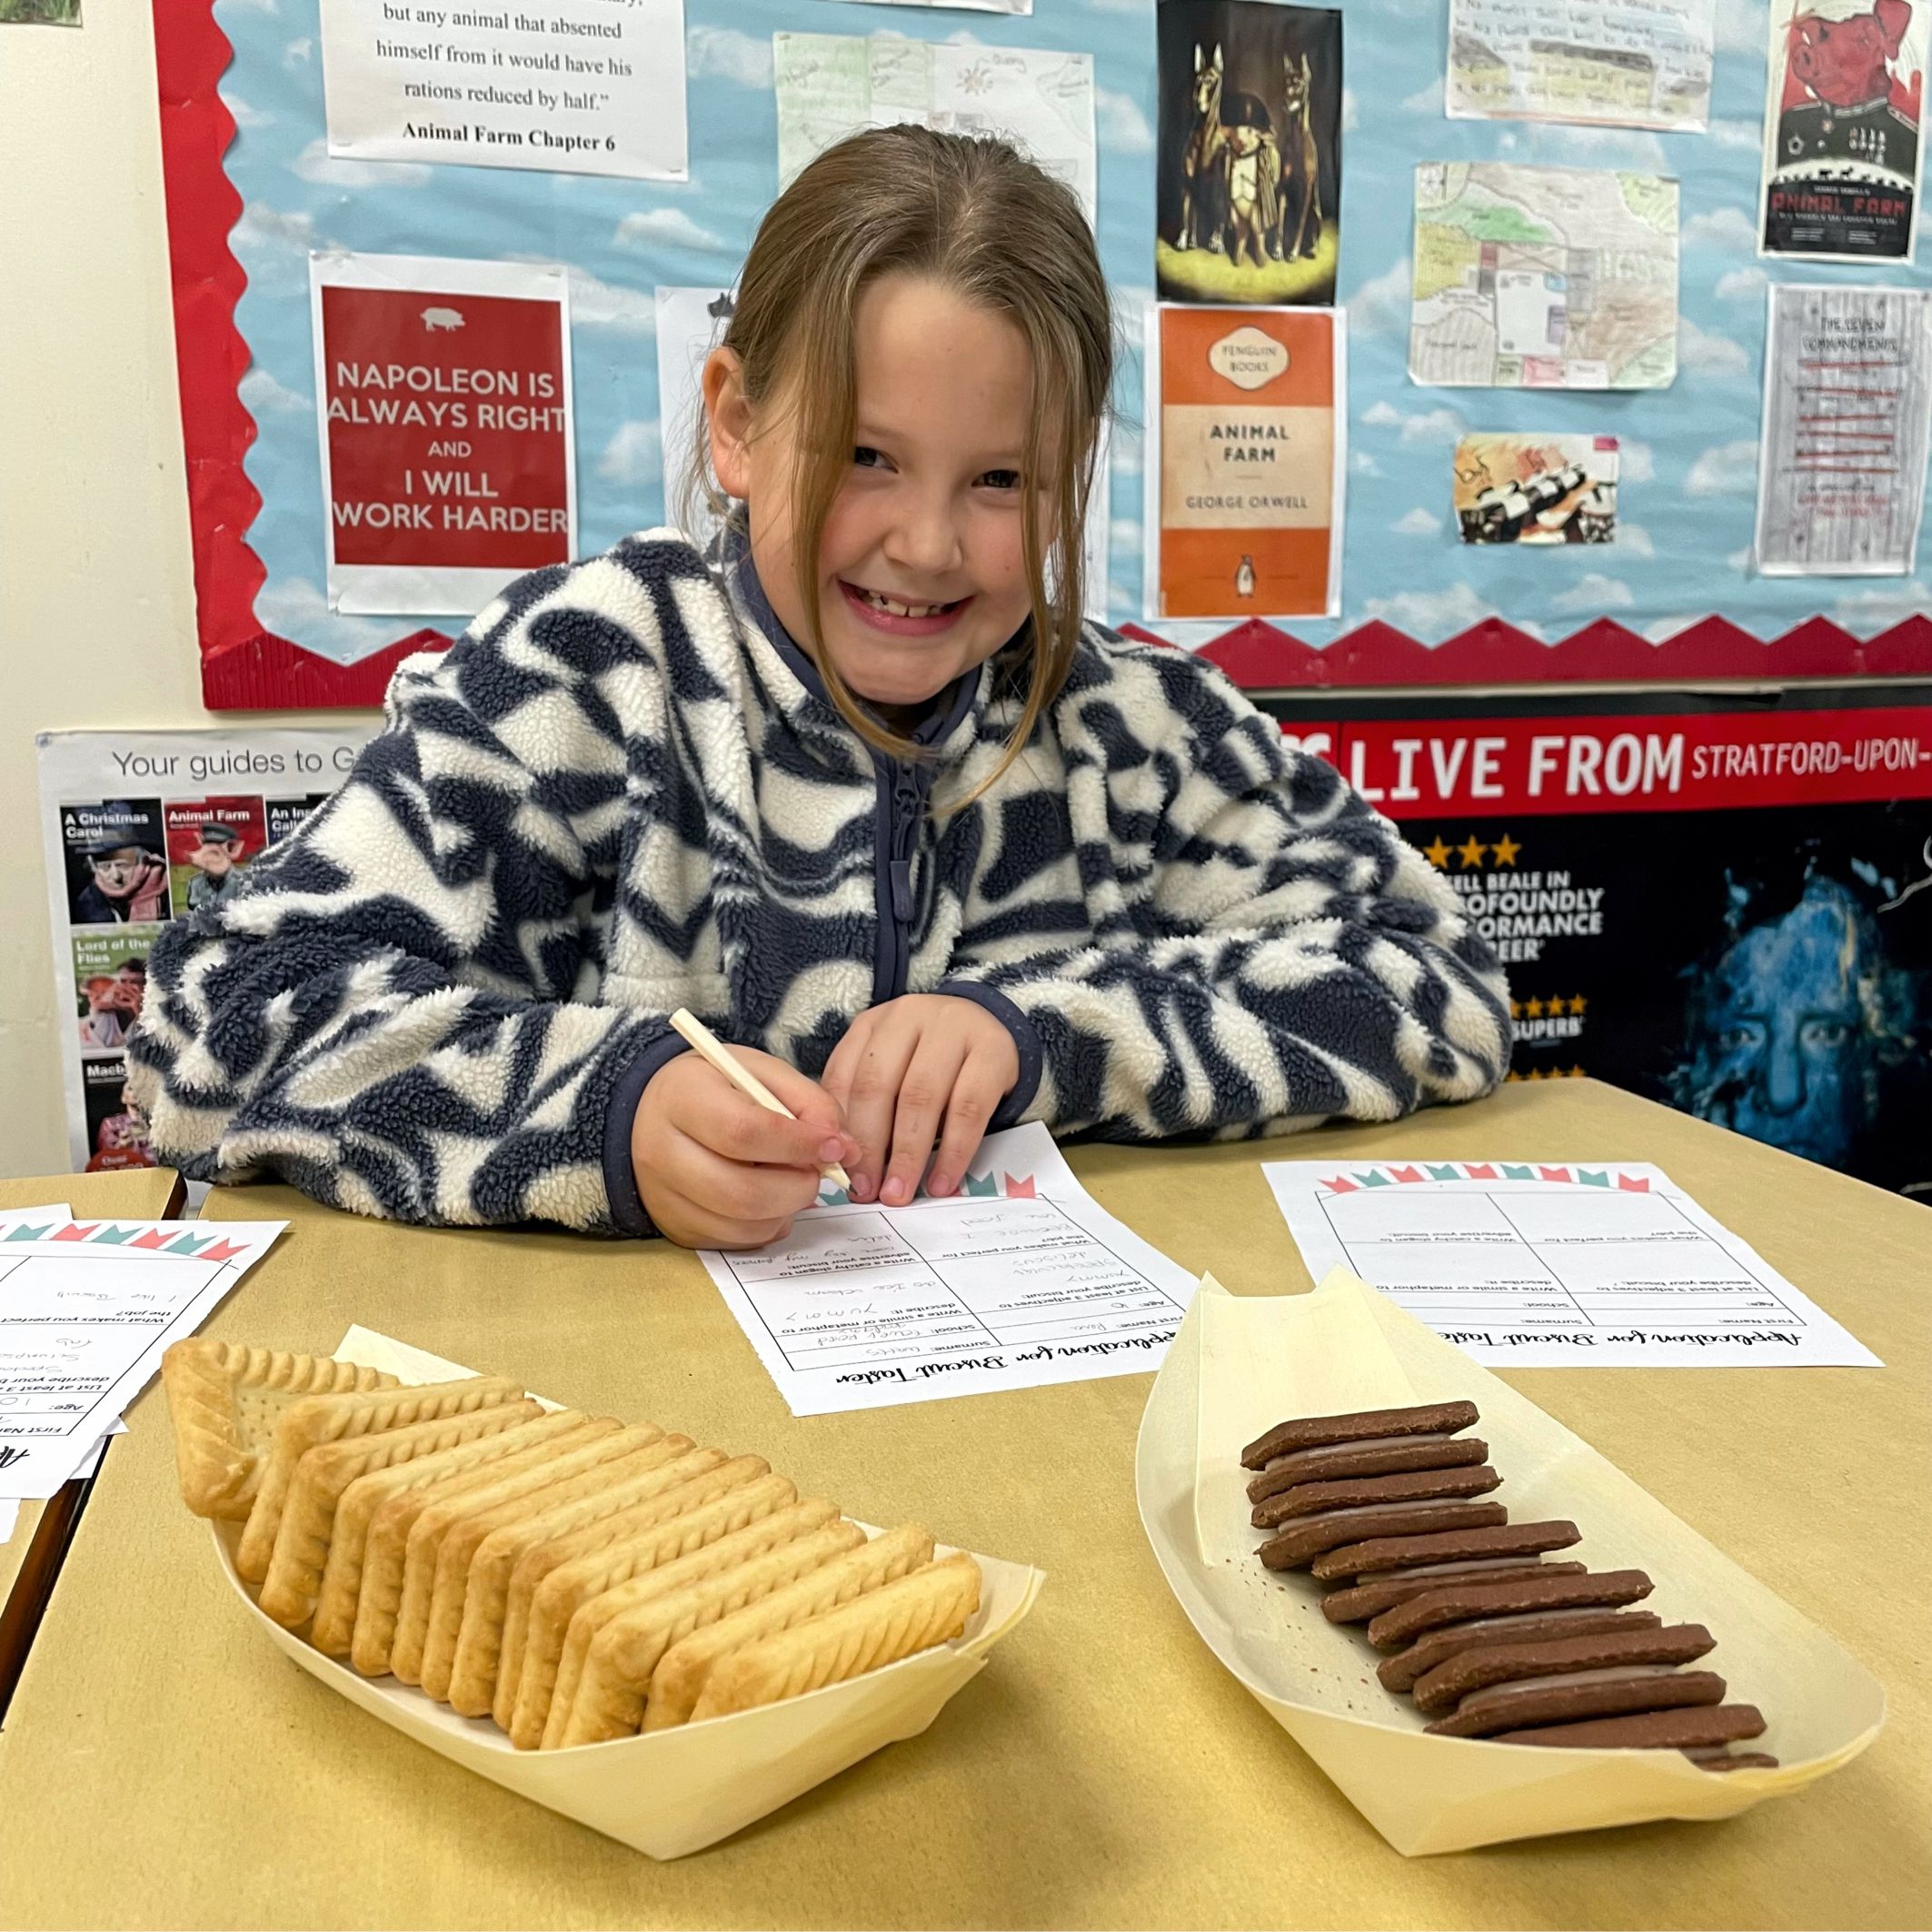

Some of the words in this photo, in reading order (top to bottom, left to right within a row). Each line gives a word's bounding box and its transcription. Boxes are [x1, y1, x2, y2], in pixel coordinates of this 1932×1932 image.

[383, 5, 411, 23] but
[416, 12, 447, 28] any
[453, 12, 509, 30] animal
[514, 15, 545, 33] that
[551, 20, 622, 39] absented
[376, 40, 443, 62] himself
[447, 45, 486, 65] from
[492, 49, 503, 67] it
[509, 53, 561, 72] would
[565, 55, 603, 75] have
[608, 59, 632, 76] his
[404, 82, 463, 101] rations
[467, 85, 533, 106] reduced
[539, 89, 558, 111] by
[403, 122, 468, 142] Animal
[474, 125, 523, 145] Farm
[529, 129, 601, 154] Chapter
[604, 135, 616, 152] 6
[1221, 345, 1278, 357] PENGUIN
[1229, 362, 1270, 373] BOOKS
[336, 362, 519, 397] NAPOLEON
[528, 373, 554, 398] IS
[327, 397, 468, 428] ALWAYS
[477, 405, 566, 433] RIGHT
[1210, 424, 1290, 440] ANIMAL
[427, 441, 472, 458] AND
[1223, 447, 1276, 463] FARM
[404, 470, 413, 494] I
[422, 470, 499, 498] WILL
[1185, 496, 1244, 509] GEORGE
[1248, 496, 1309, 510] ORWELL
[332, 502, 433, 530] WORK
[442, 505, 568, 533] HARDER
[113, 751, 179, 779] Your
[190, 749, 285, 781] guides
[295, 749, 323, 772] to
[333, 746, 355, 772] G
[1350, 737, 1507, 802] LIVE
[1528, 732, 1686, 797] FROM
[1691, 736, 1932, 780] STRATFORD-UPON-
[65, 813, 75, 826] A
[78, 812, 149, 826] Christmas
[169, 810, 214, 822] Animal
[217, 810, 250, 822] Farm
[271, 807, 289, 819] An
[293, 806, 312, 819] Ins
[66, 826, 103, 839] Carol
[1487, 872, 1542, 891] BEALE
[1547, 870, 1570, 889] IN
[1460, 888, 1605, 917] OFOUNDLY
[1477, 911, 1604, 940] ORMANCE
[76, 940, 107, 951] Lord
[128, 939, 150, 950] the
[76, 953, 110, 965] Flies
[86, 1063, 125, 1077] Macb
[1041, 1233, 1065, 1243] job?
[1061, 1239, 1090, 1248] What
[961, 1248, 999, 1258] perfect
[1001, 1244, 1021, 1253] you
[1024, 1241, 1059, 1252] makes
[830, 1256, 855, 1266] your
[858, 1251, 911, 1261] advertise
[883, 1256, 916, 1265] Write
[787, 1260, 829, 1270] biscuit:
[794, 1264, 832, 1274] slogan
[833, 1259, 872, 1270] catchy
[1065, 1285, 1090, 1296] your
[1093, 1280, 1141, 1292] describe
[1391, 1283, 1453, 1291] metaphor
[1014, 1294, 1072, 1309] adjectives
[1020, 1290, 1063, 1300] biscuit:
[1085, 1290, 1112, 1300] least
[907, 1303, 956, 1313] describe
[927, 1308, 962, 1318] Write
[878, 1314, 915, 1324] simile
[1116, 1320, 1156, 1329] Name:
[802, 1320, 860, 1332] metaphor
[931, 1324, 976, 1334] School:
[1438, 1332, 1504, 1347] Taste
[1500, 1332, 1598, 1347] Biscuit
[1607, 1329, 1647, 1344] for
[1651, 1331, 1802, 1347] Application
[931, 1340, 991, 1353] Surname:
[1058, 1331, 1176, 1356] pplication
[1015, 1346, 1053, 1362] for
[914, 1356, 1009, 1379] Biscuit
[835, 1367, 916, 1385] Taster
